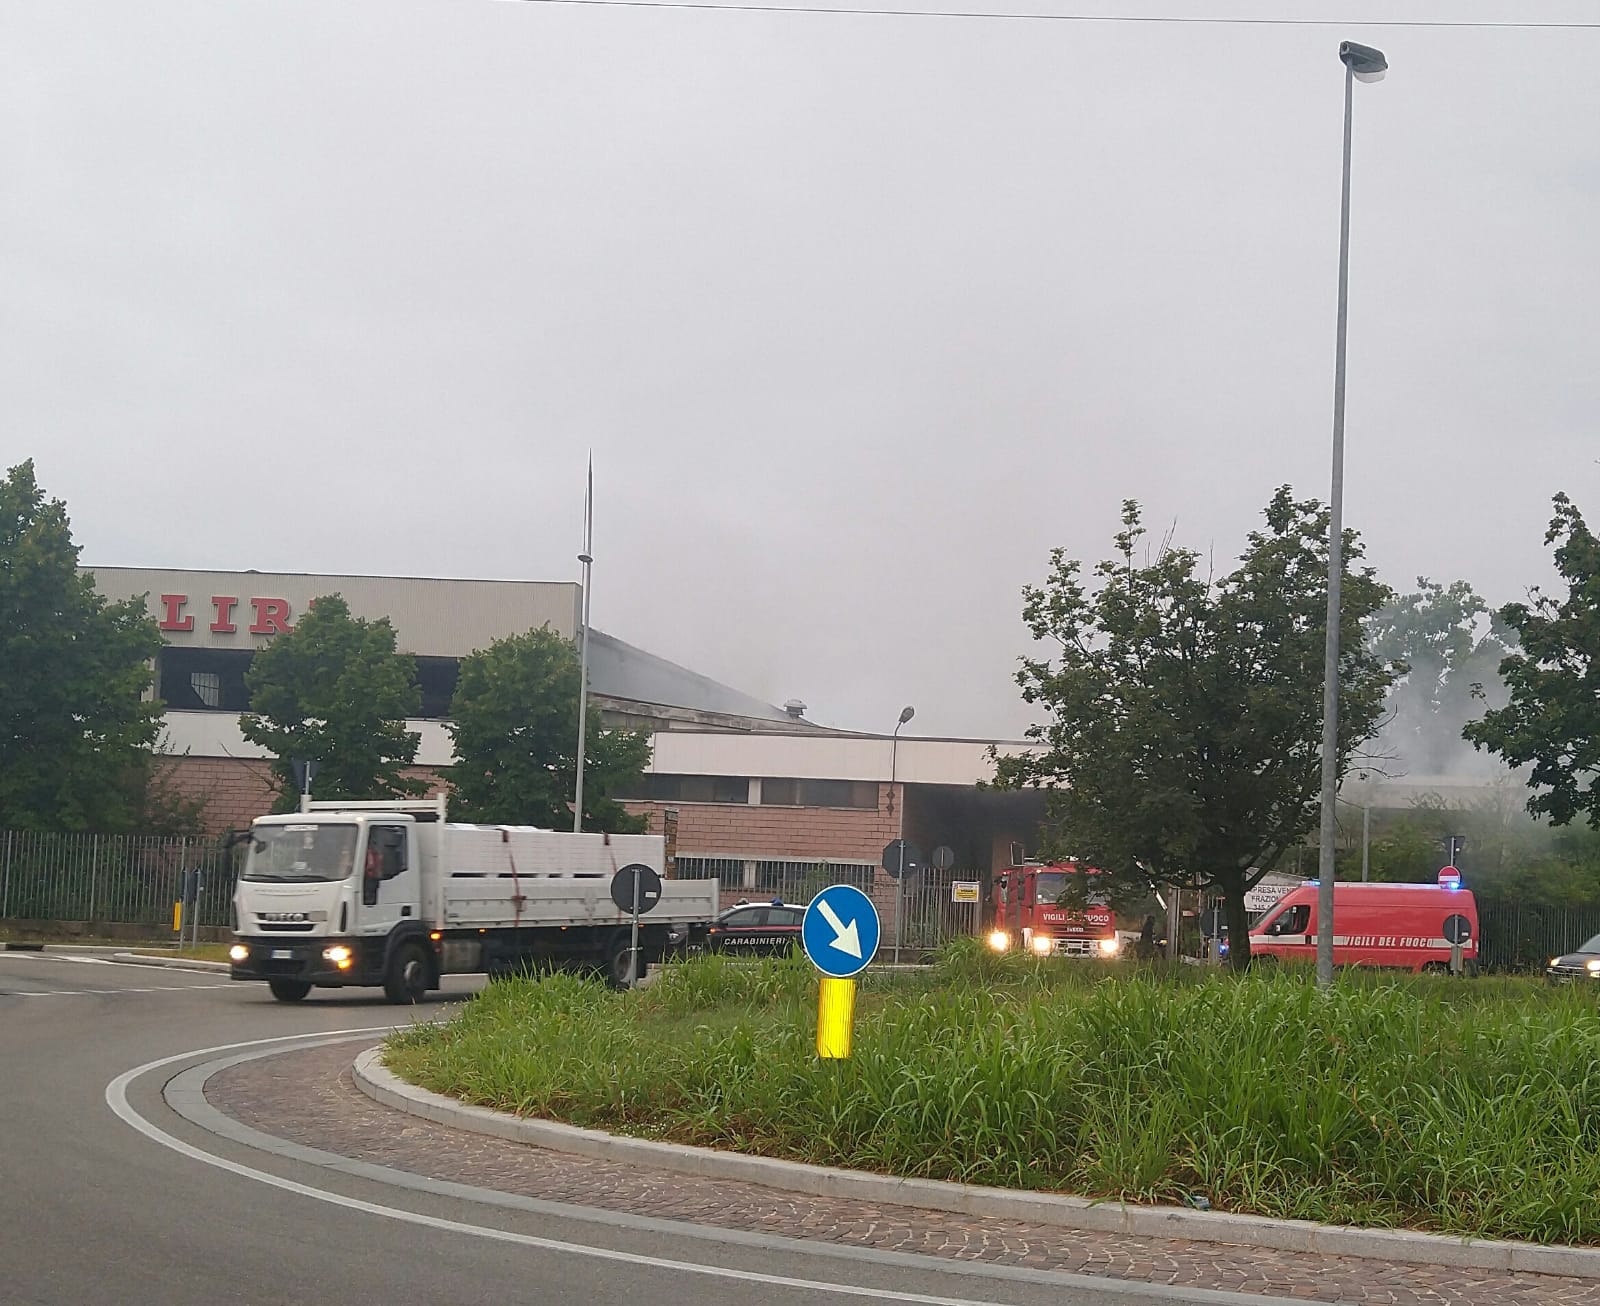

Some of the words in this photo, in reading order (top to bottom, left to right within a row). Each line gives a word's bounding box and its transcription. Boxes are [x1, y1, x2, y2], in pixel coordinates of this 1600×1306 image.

[159, 594, 316, 634] LIR
[1252, 886, 1276, 894] PRESA
[1251, 895, 1280, 903] FRAZION
[1043, 913, 1065, 921] VIGILI
[724, 937, 786, 946] CARABINIERI
[1344, 936, 1375, 946] VIGILI
[1378, 936, 1396, 947] DEL
[1400, 937, 1433, 948] FUOCO
